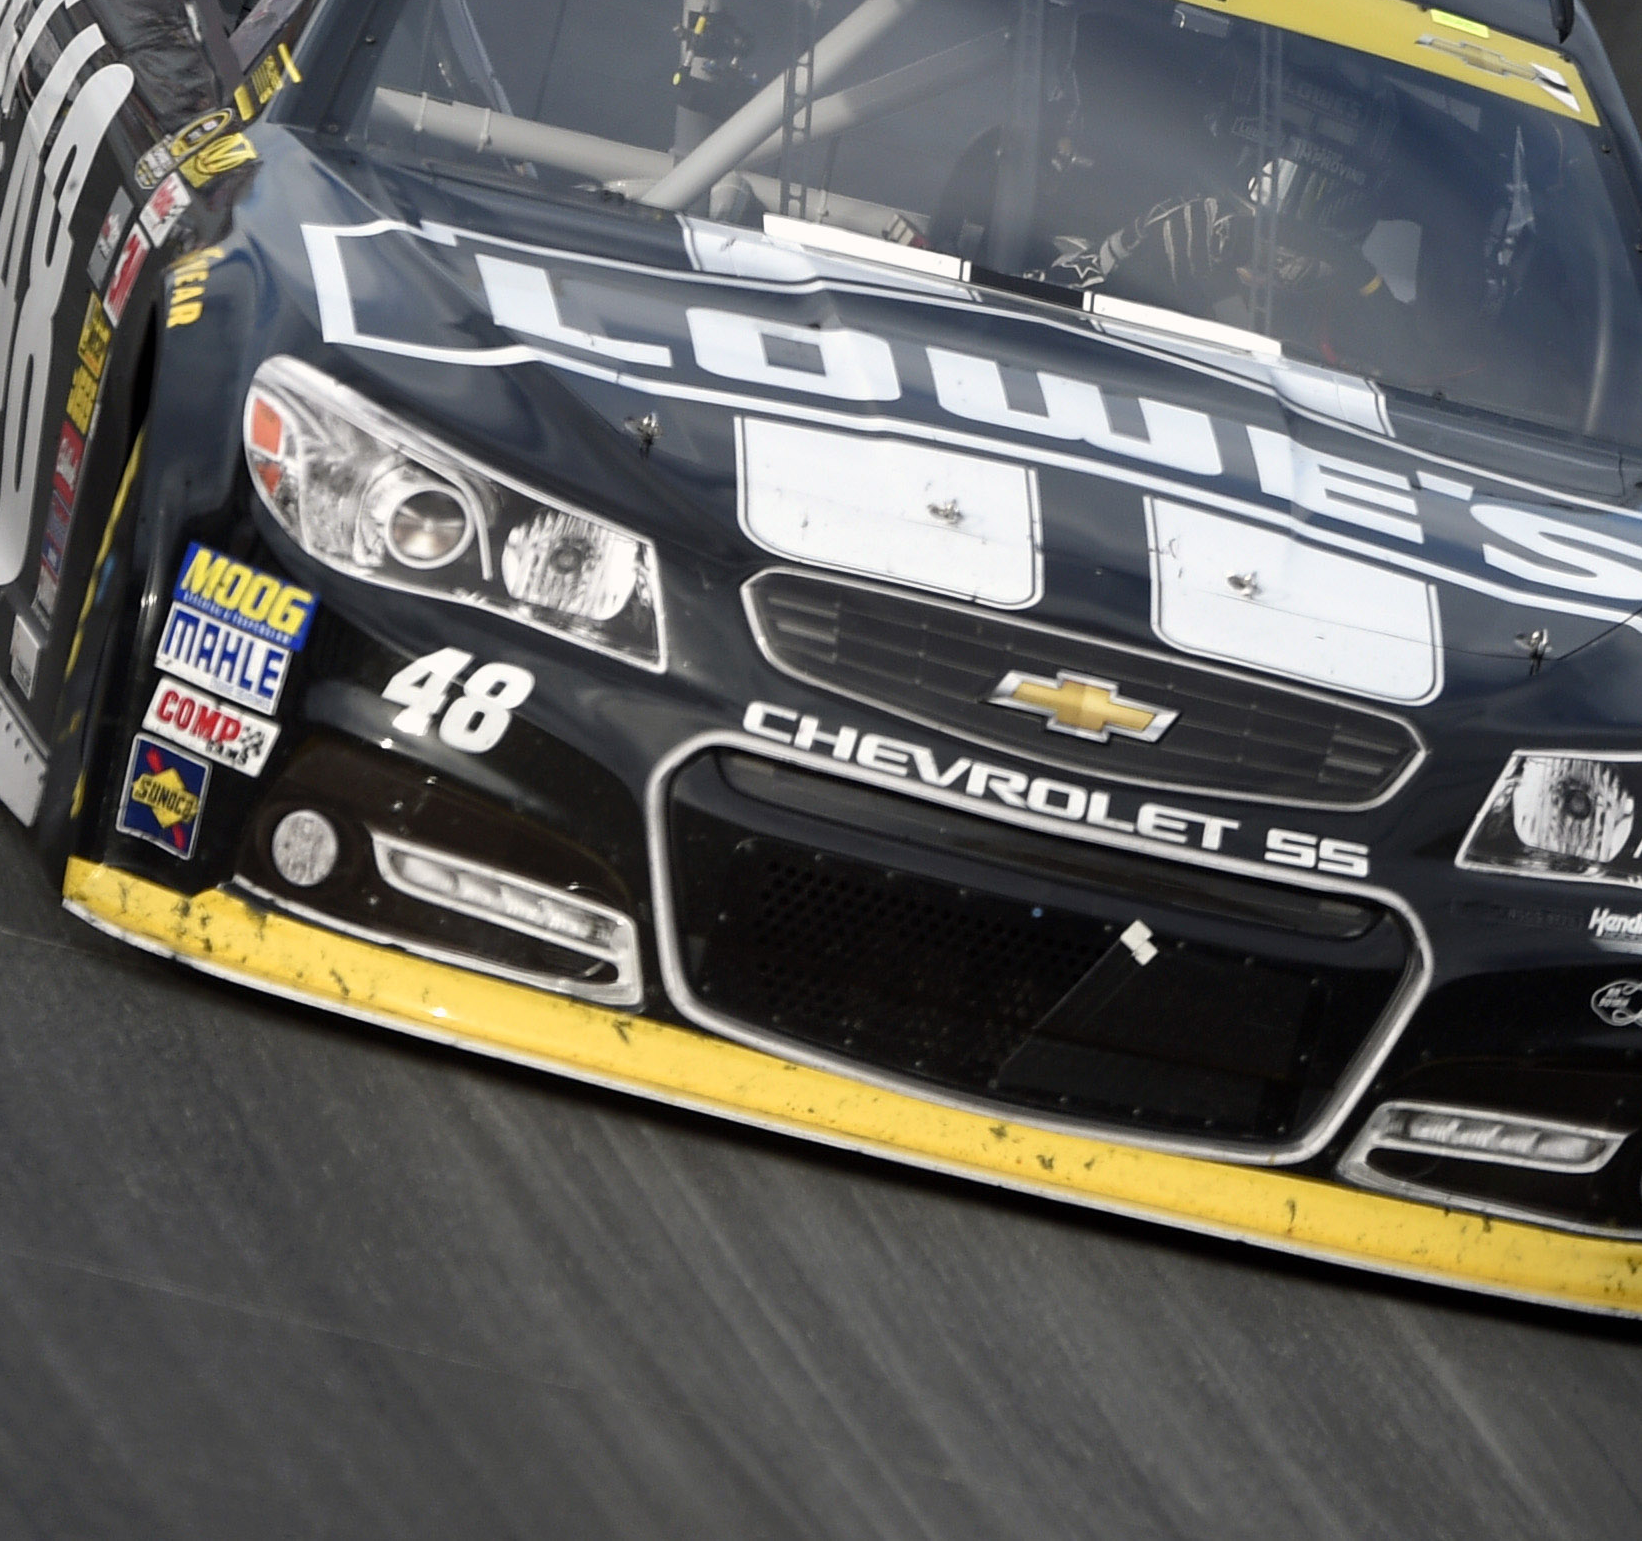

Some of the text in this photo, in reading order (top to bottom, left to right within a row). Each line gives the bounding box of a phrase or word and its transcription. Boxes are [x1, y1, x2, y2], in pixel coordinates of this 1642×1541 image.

[181, 548, 314, 636] MOOG
[163, 609, 285, 699] MAHLE
[156, 690, 241, 746] COMP
[381, 647, 535, 754] 48
[137, 777, 197, 817] SUNOCO
[742, 701, 1370, 878] CHEVROLET SS
